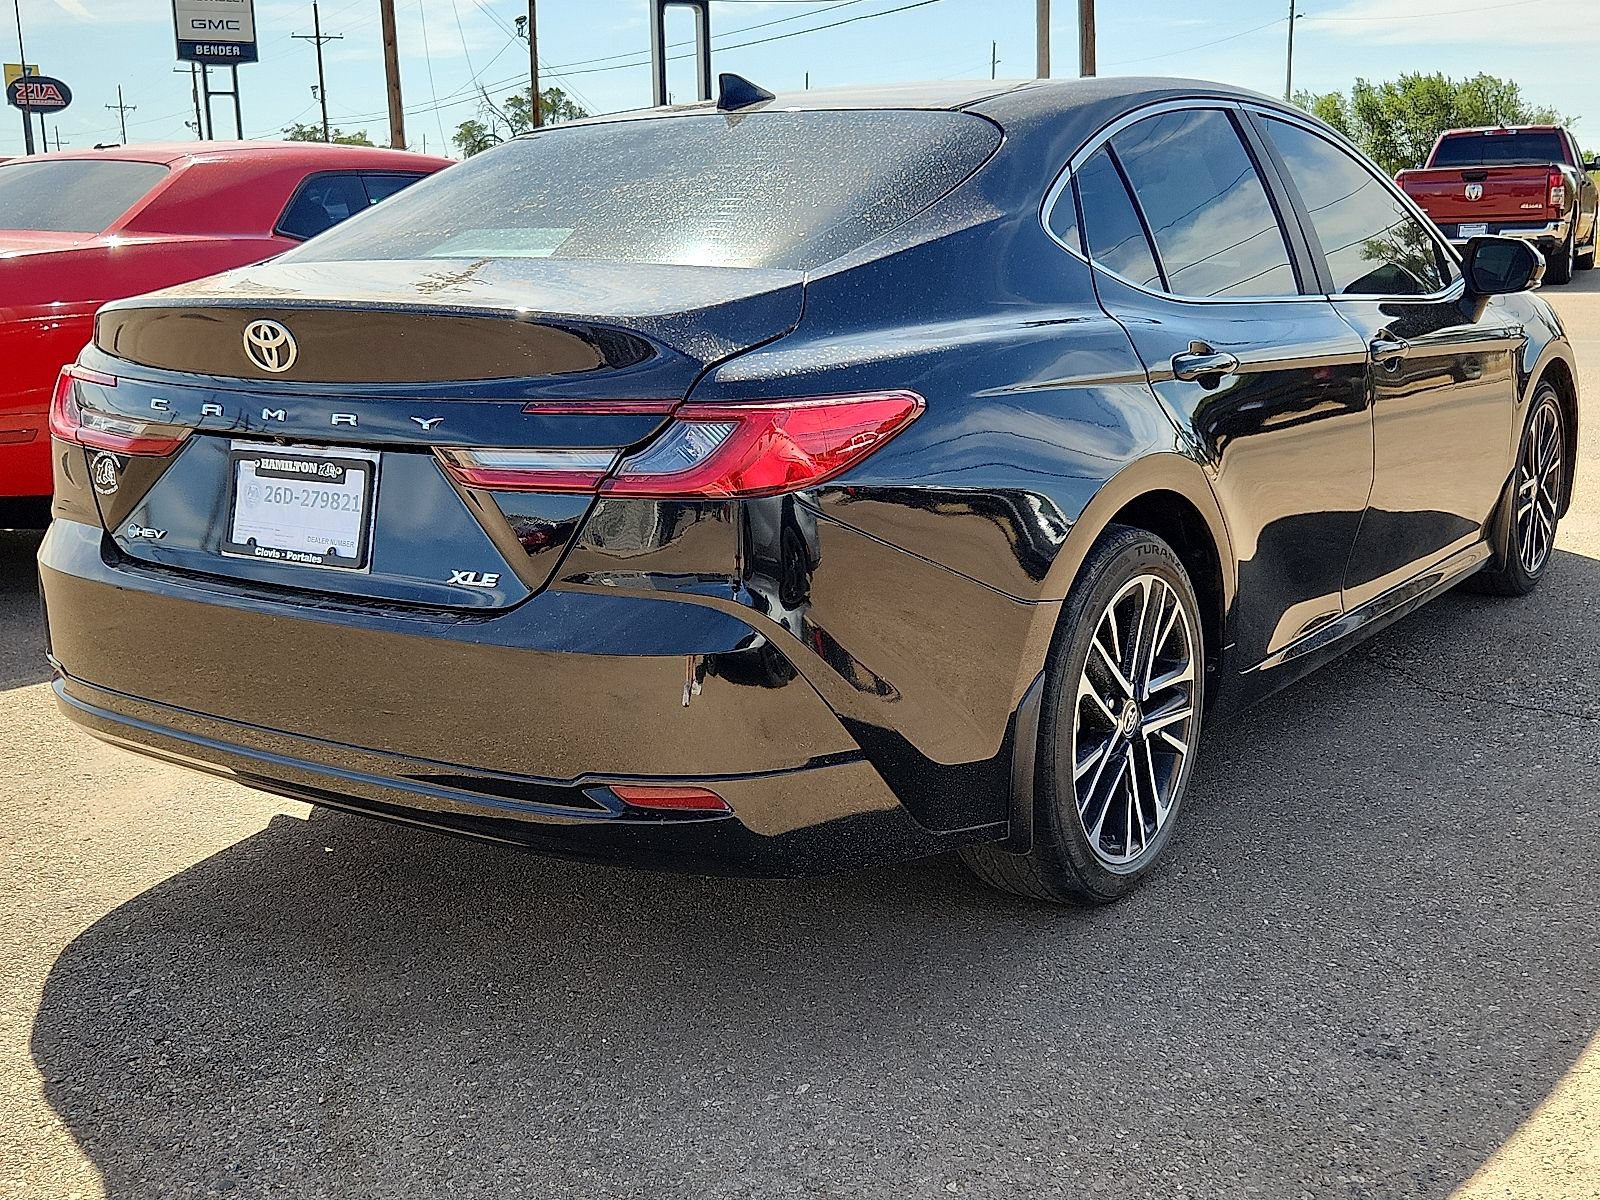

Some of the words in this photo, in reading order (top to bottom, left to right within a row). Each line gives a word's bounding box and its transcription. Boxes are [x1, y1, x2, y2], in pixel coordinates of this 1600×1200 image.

[191, 19, 240, 30] GMC
[195, 45, 240, 56] BENDER
[14, 83, 63, 100] ZIA
[150, 398, 444, 430] CAMRY
[260, 458, 318, 474] HAMILTON
[264, 485, 360, 513] 26D-279821
[136, 526, 167, 539] HEV
[307, 535, 329, 545] DEALER
[330, 538, 355, 548] NUMBER
[255, 547, 281, 559] Clovis
[286, 551, 323, 564] Portales
[446, 569, 500, 588] XLE
